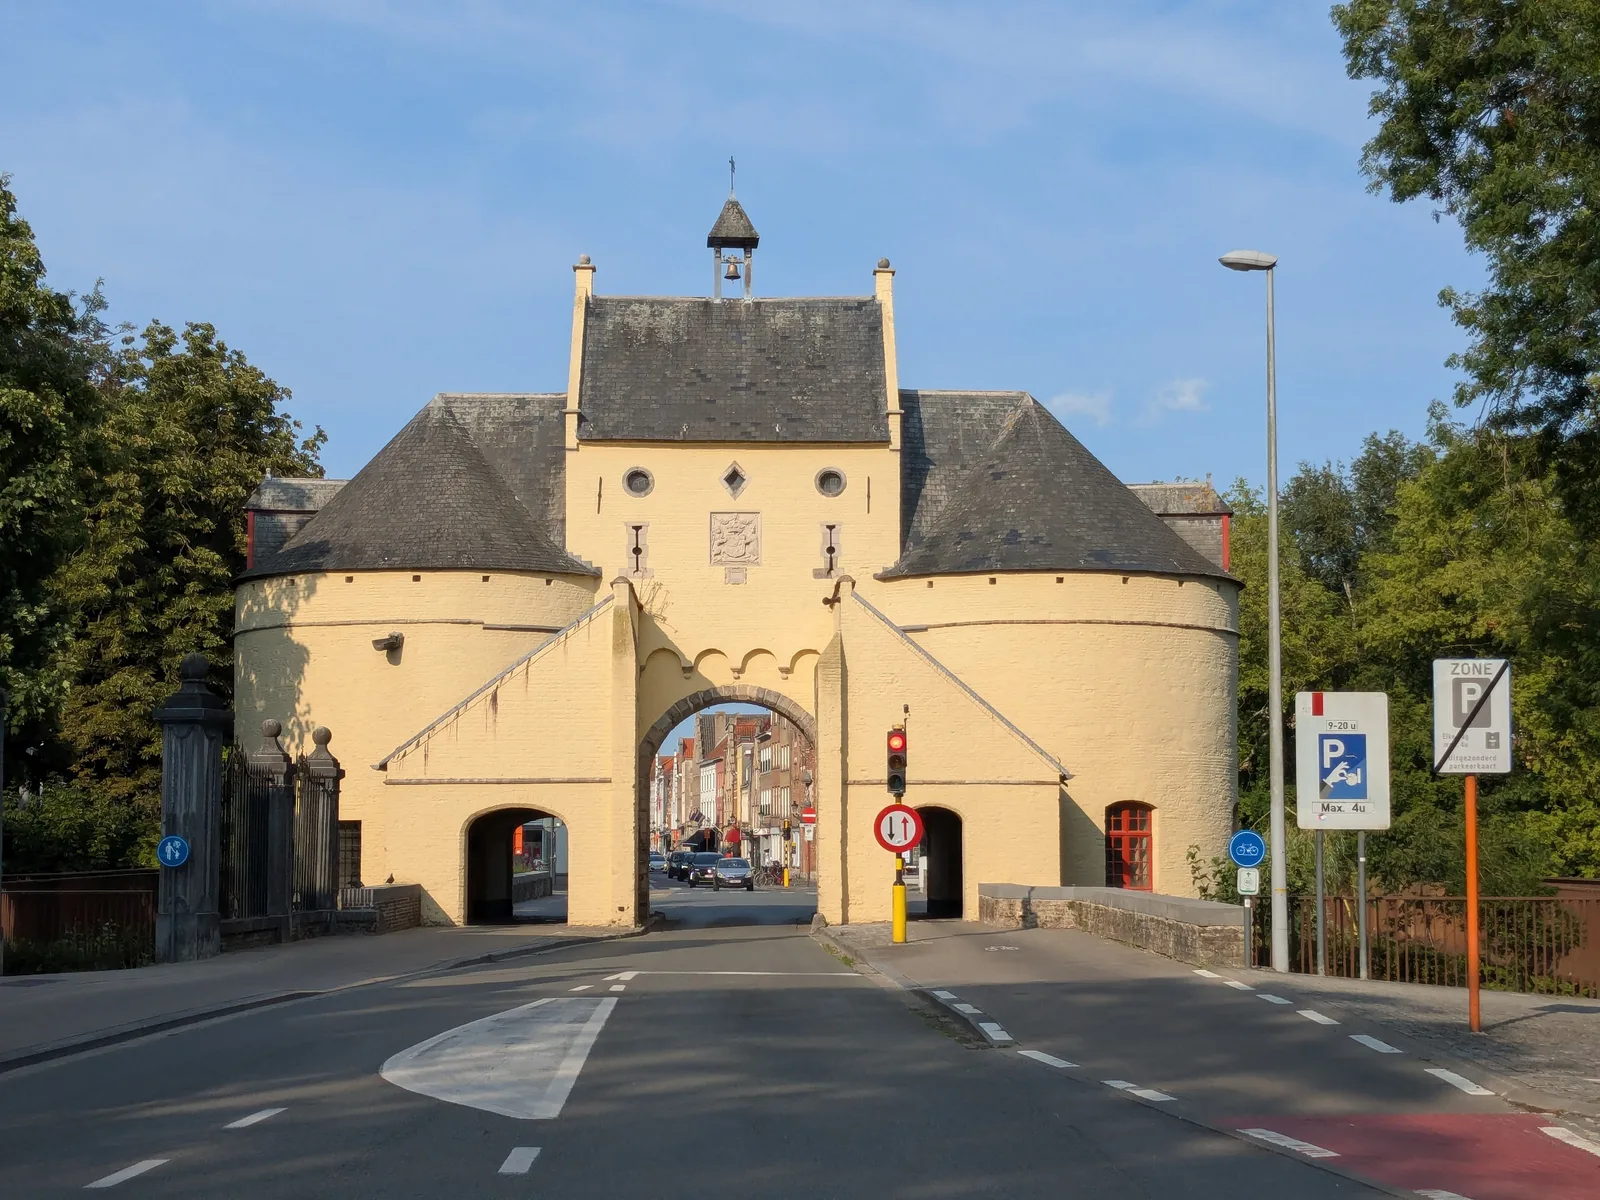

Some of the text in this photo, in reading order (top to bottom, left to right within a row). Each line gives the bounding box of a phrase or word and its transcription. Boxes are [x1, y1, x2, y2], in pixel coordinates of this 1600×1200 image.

[1450, 662, 1492, 675] ZONE
[1461, 682, 1482, 714] P
[1328, 721, 1356, 730] 9-20 u
[1323, 739, 1345, 768] P
[1321, 803, 1366, 813] Max. 4u
